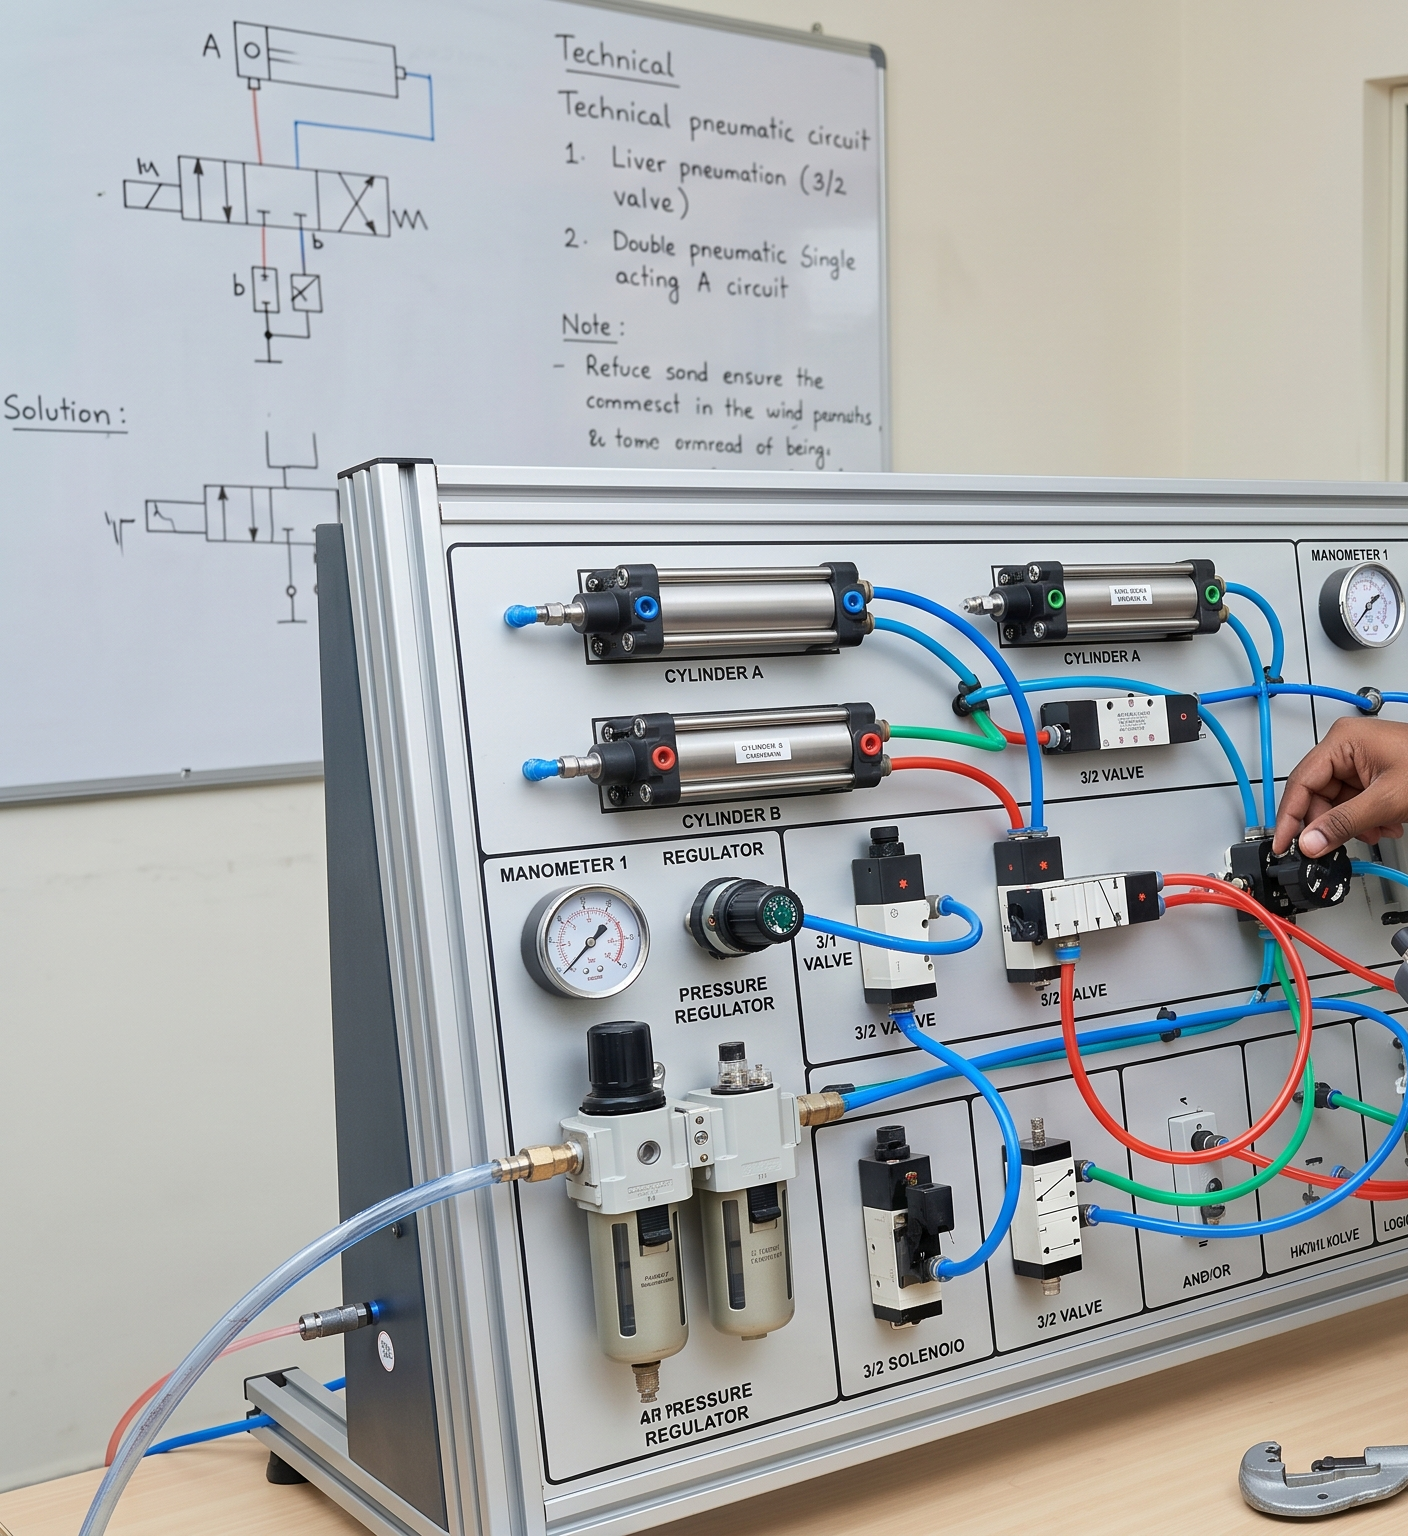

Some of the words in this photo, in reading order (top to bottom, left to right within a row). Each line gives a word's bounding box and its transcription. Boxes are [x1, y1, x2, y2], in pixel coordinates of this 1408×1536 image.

[202, 33, 221, 58] A
[555, 33, 675, 78] Technical
[557, 90, 671, 129] Technical
[690, 116, 794, 142] pneumatic
[808, 125, 871, 151] circuit
[612, 145, 666, 173] Liver
[680, 161, 787, 187] pneumation
[800, 164, 847, 197] (3/2
[613, 186, 690, 220] valve)
[613, 229, 676, 257] Double
[690, 241, 787, 267] pneumatic
[800, 244, 856, 280] Single
[616, 265, 680, 304] acting
[697, 271, 711, 293] A
[727, 276, 789, 299] circuit
[722, 369, 783, 387] ensure
[796, 367, 825, 389] the
[696, 398, 713, 415] in
[725, 398, 755, 420] the
[767, 399, 803, 421] wind
[1311, 549, 1380, 561] MANOMETER
[1383, 549, 1388, 560] 1
[1064, 650, 1128, 665] CYLINDER
[1130, 649, 1141, 663] A
[664, 666, 748, 684] CYLINDER
[751, 665, 764, 680] A
[1080, 769, 1099, 784] 3/2
[1102, 766, 1144, 782] VALVE
[682, 807, 765, 829] CYLINDER
[769, 806, 781, 821] B
[662, 841, 764, 865] REGULATOR
[500, 857, 614, 883] MANOMETER
[620, 855, 628, 870] 1
[816, 934, 836, 949] 3/1
[803, 952, 853, 971] VALVE
[679, 976, 768, 1002] PRESSURE
[1072, 983, 1107, 1001] ALVE
[674, 996, 775, 1024] REGULATOR
[855, 1023, 877, 1040] 3/2
[880, 1012, 936, 1036] VAVE
[1037, 1312, 1056, 1329] 3/2
[1060, 1299, 1103, 1323] VALVE
[863, 1360, 884, 1379] 3/2
[665, 1382, 753, 1419] PRESSURE
[645, 1406, 750, 1447] REGULATOR
